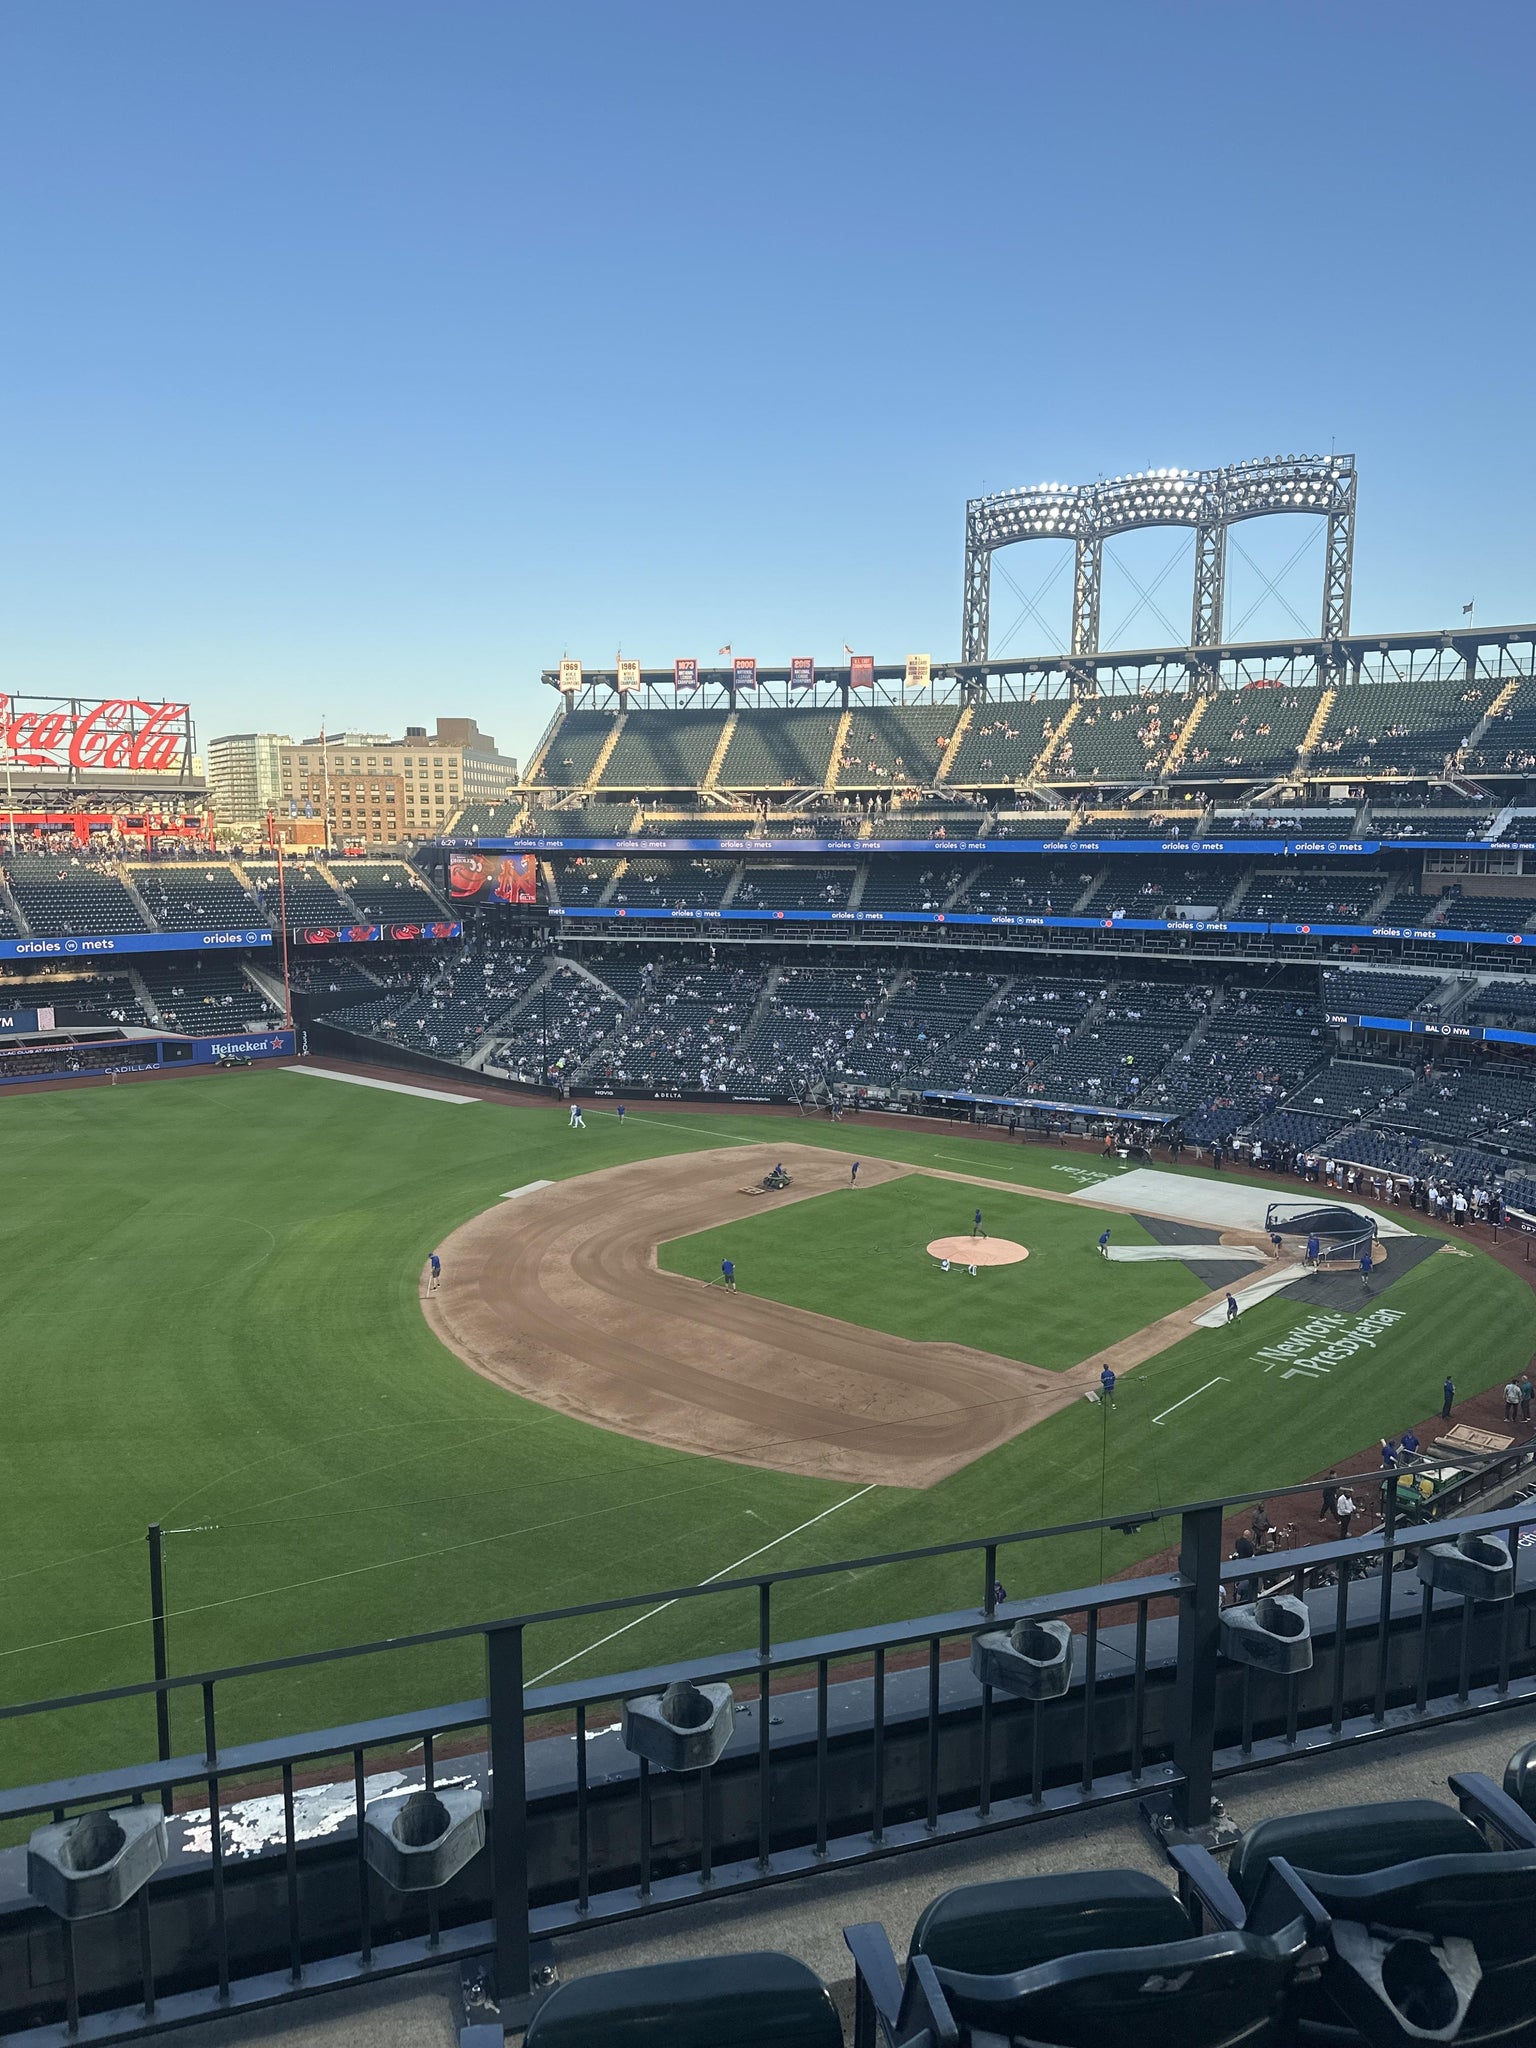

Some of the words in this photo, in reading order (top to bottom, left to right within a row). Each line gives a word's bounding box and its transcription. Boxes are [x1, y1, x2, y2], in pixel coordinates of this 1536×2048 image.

[736, 661, 754, 669] 2000
[794, 660, 811, 669] 2015
[441, 839, 456, 847] 6:29
[616, 840, 639, 848] orioles
[720, 841, 744, 849] orioles
[828, 841, 851, 849] orioles
[1043, 842, 1068, 850] orioles
[1162, 842, 1189, 850] orioles
[1295, 842, 1325, 850] orioles
[1339, 843, 1363, 851] mets
[831, 911, 854, 919] orioles
[865, 912, 883, 920] mets
[992, 915, 1015, 923] orioles
[1167, 921, 1194, 929] orioles
[1206, 922, 1227, 930] mets
[1372, 928, 1400, 937] orioles
[1414, 930, 1436, 938] mets
[203, 932, 242, 944] orioles
[16, 940, 61, 953] orioles
[81, 939, 114, 950] mets
[1331, 1015, 1347, 1023] NYM
[1425, 1024, 1440, 1033] BAL
[1452, 1027, 1470, 1036] NYM
[211, 1040, 268, 1055] Heineken
[104, 1063, 160, 1075] CADILLAC
[1293, 1308, 1407, 1373] Presbyterian
